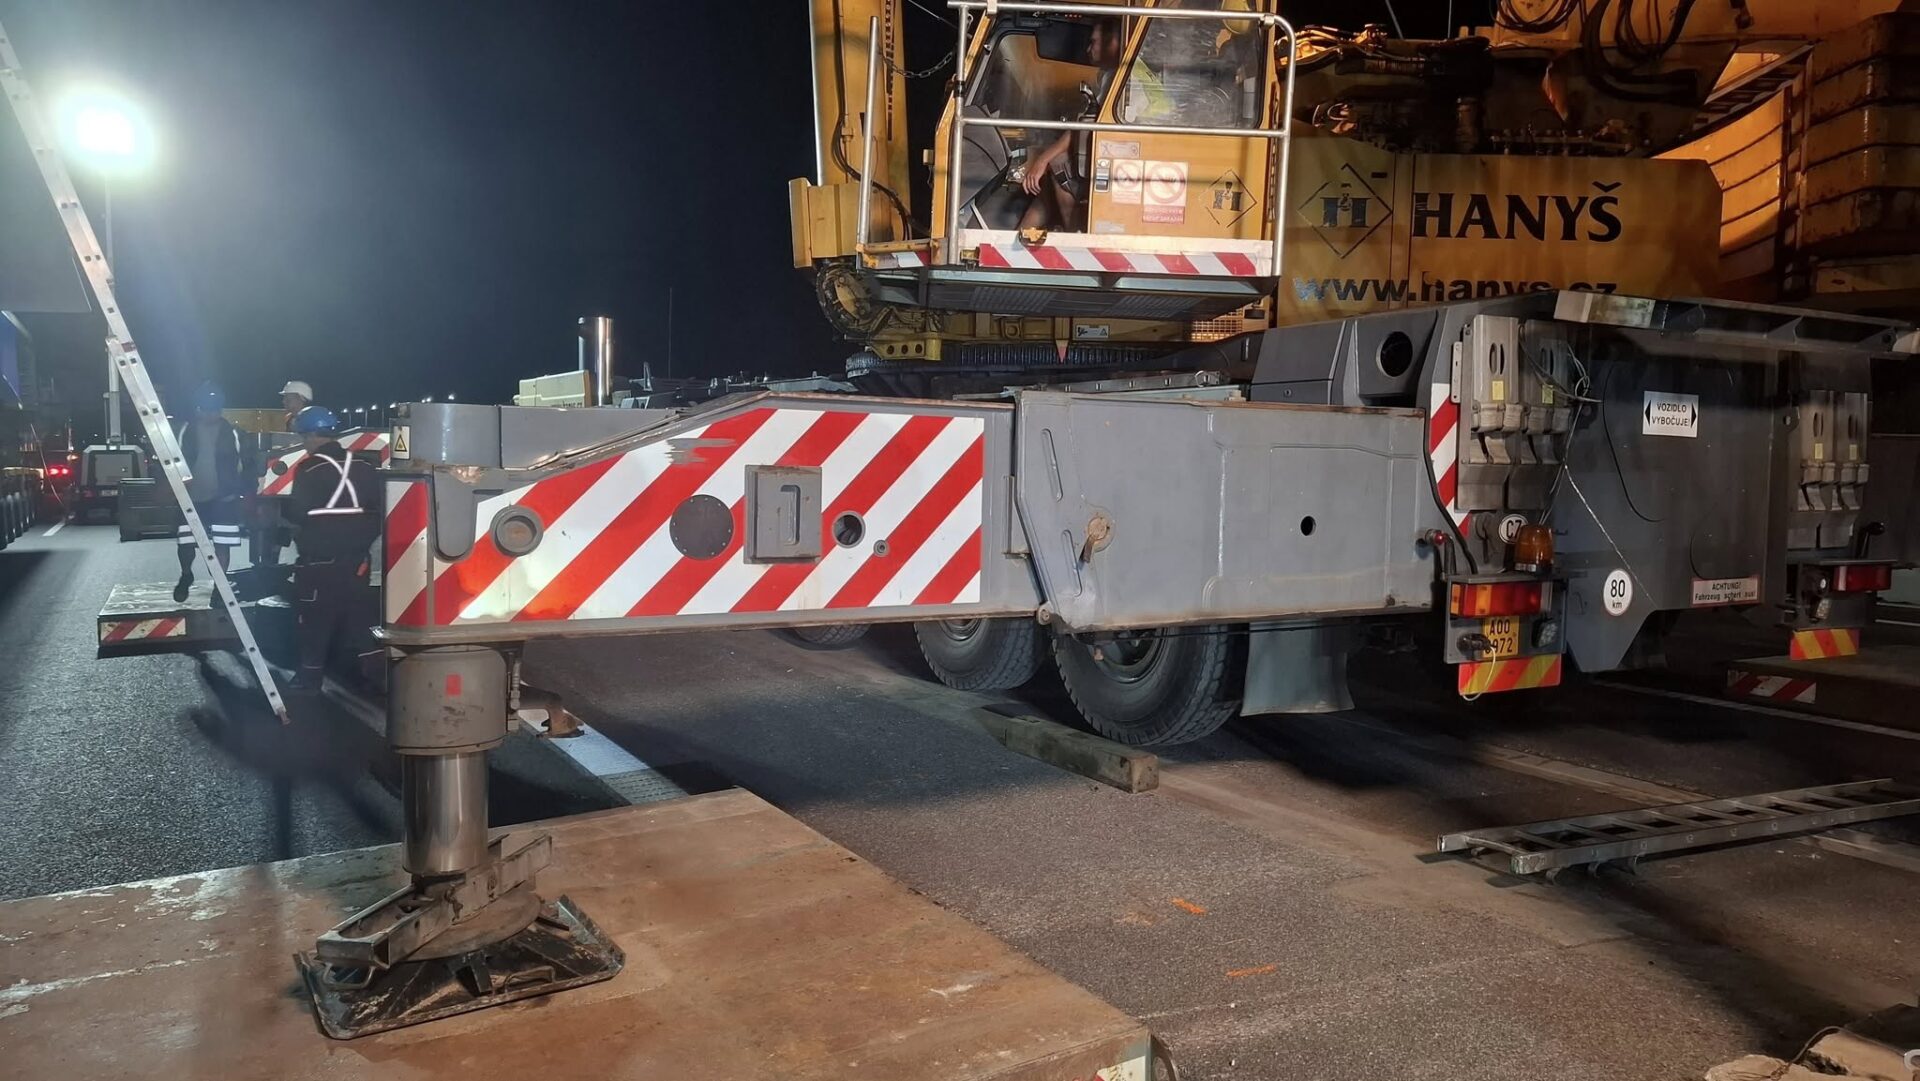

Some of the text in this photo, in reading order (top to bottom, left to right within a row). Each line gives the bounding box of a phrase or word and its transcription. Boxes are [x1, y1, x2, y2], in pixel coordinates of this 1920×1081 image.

[1411, 181, 1622, 242] HANYŠ
[1293, 271, 1617, 301] www.han
[1656, 402, 1687, 413] VOZIDLO
[1610, 579, 1626, 598] 80
[1612, 601, 1623, 609] km
